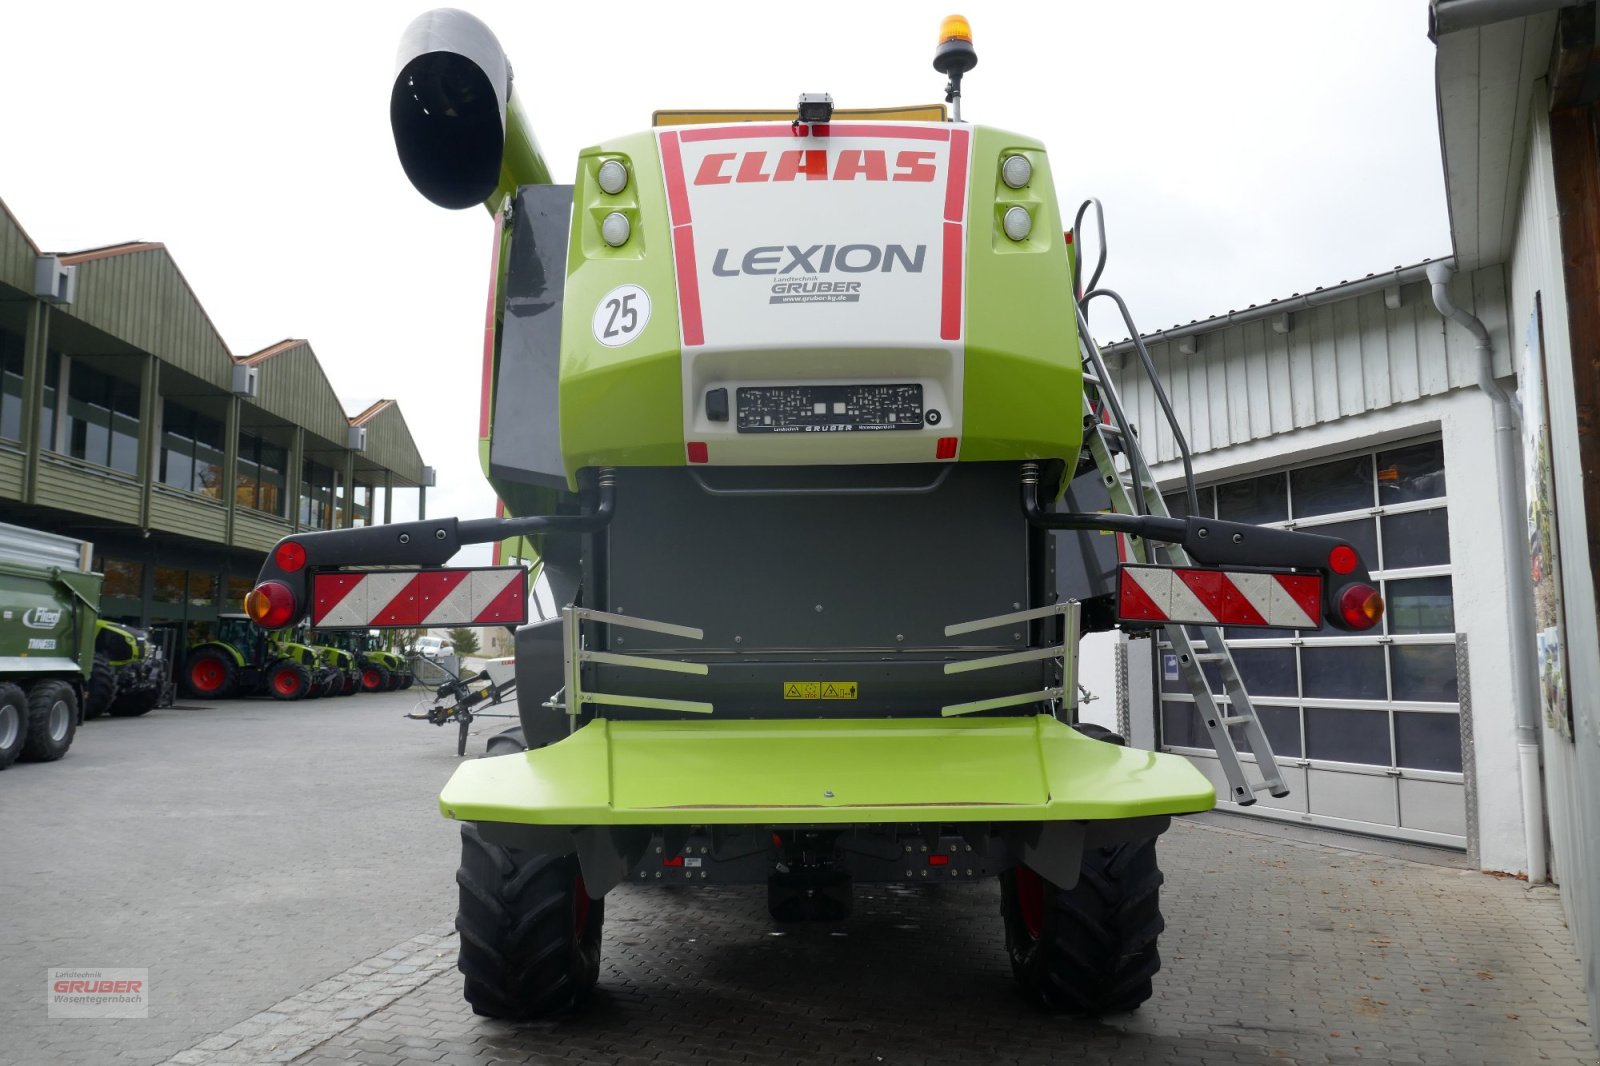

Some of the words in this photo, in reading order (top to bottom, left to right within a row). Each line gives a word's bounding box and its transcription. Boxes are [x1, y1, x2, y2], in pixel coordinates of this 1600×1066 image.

[694, 150, 937, 186] CLAAS
[712, 244, 927, 277] LEXION
[771, 282, 861, 294] GRUBER
[782, 295, 847, 303] www.gruber-kg.de
[603, 293, 638, 339] 25
